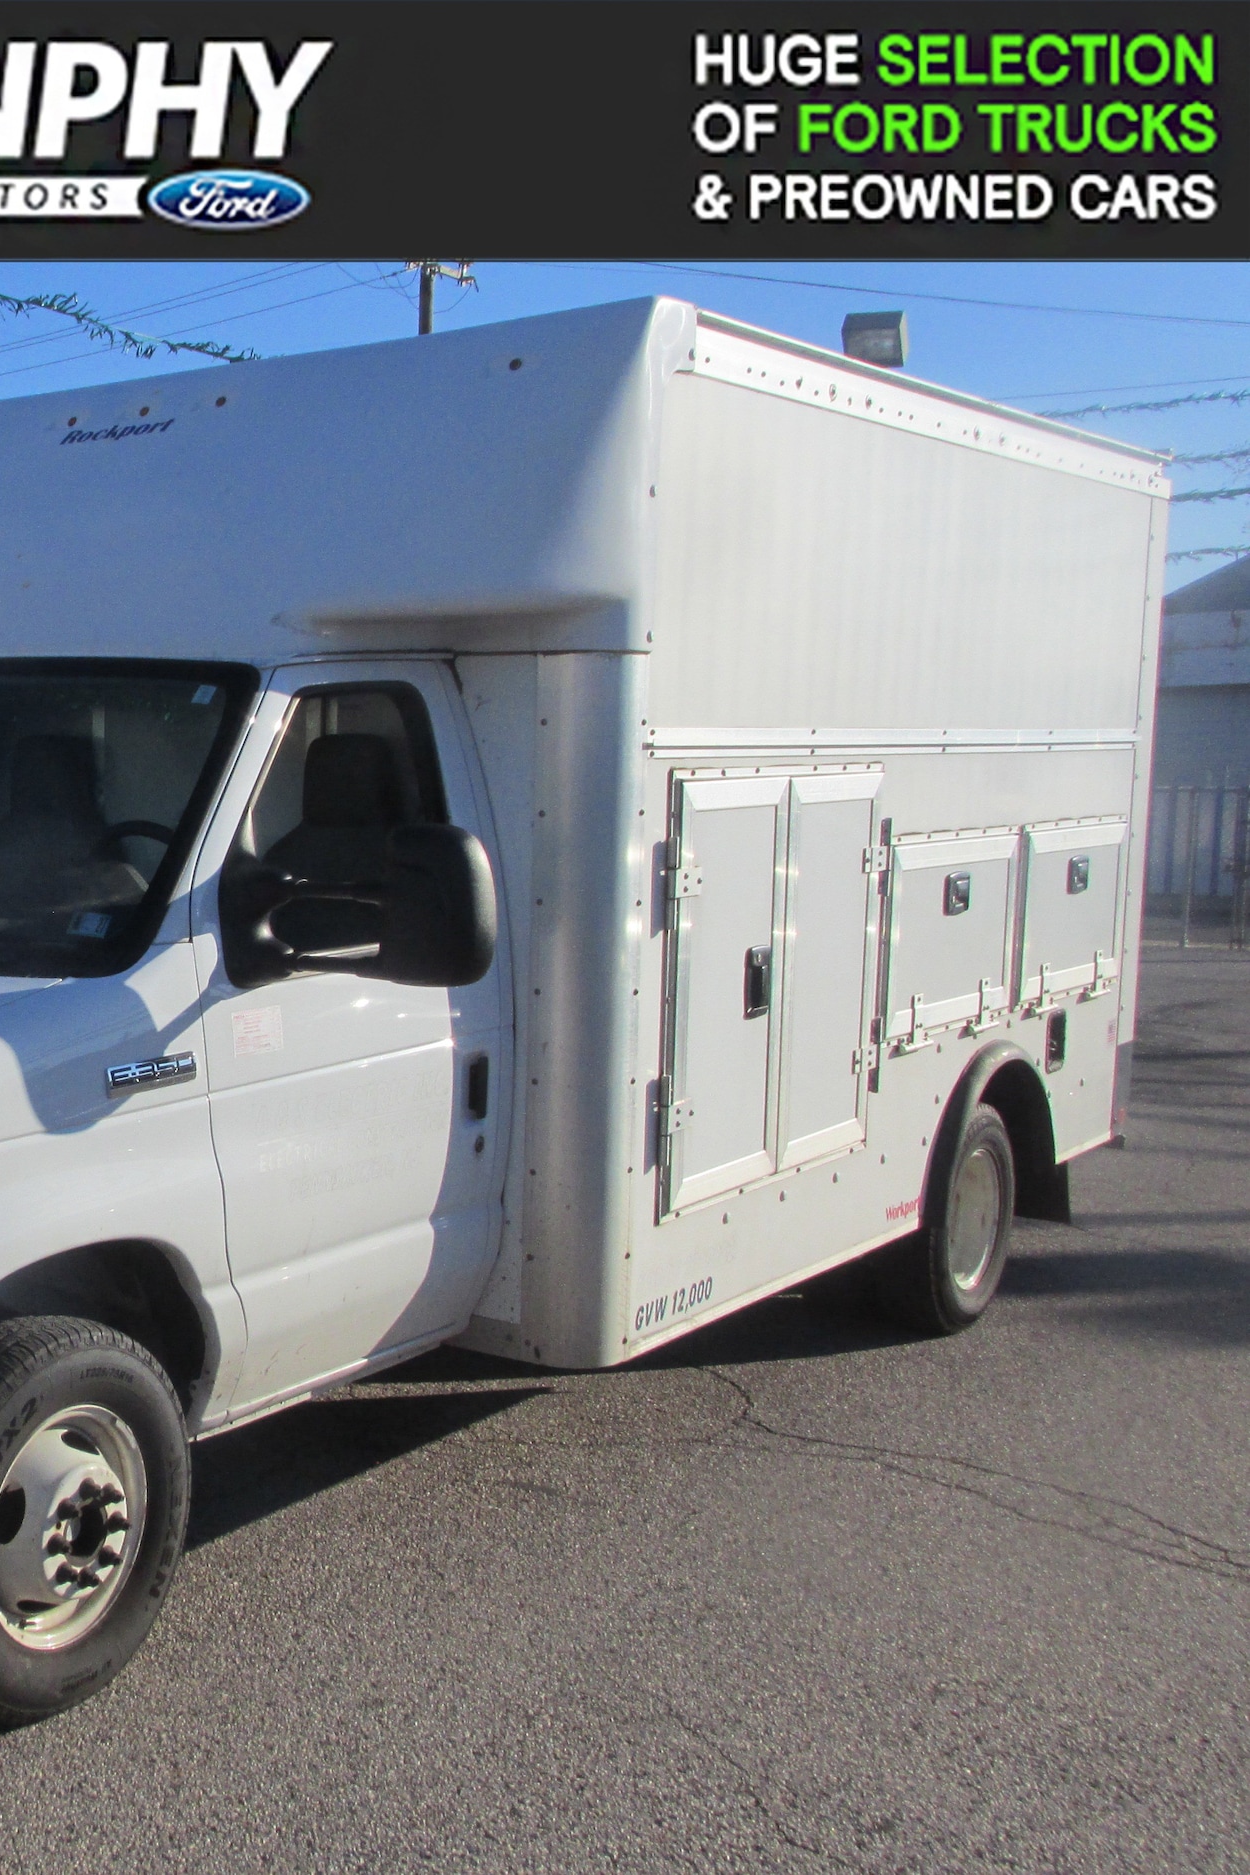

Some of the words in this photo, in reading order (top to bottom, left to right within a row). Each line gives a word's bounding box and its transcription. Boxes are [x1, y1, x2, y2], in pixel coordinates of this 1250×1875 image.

[60, 418, 175, 446] Rockport
[634, 1295, 668, 1332] GVW
[671, 1275, 714, 1315] 12,000
